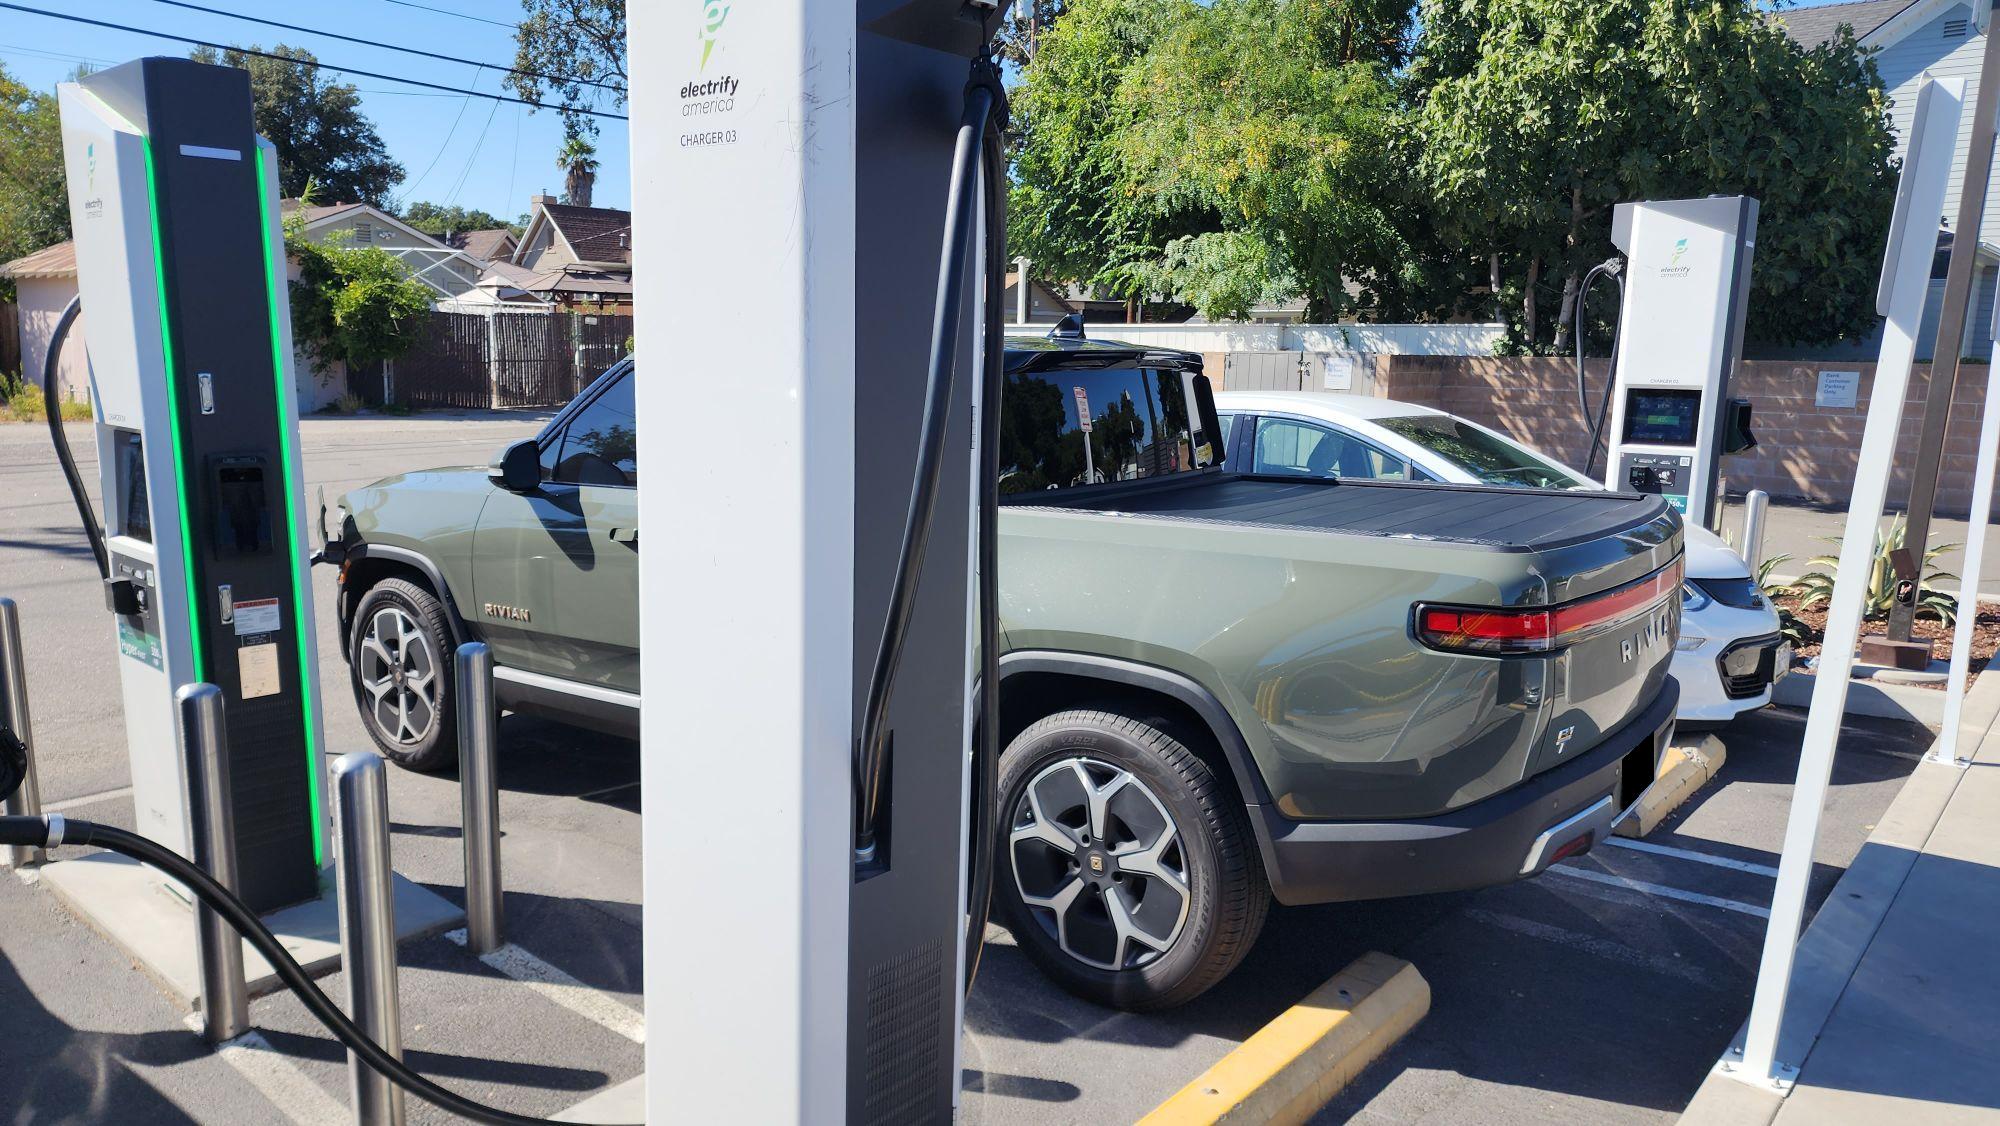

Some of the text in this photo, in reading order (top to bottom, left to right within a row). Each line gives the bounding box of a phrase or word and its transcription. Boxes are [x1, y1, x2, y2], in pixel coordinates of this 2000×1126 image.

[680, 75, 739, 98] electrify
[682, 97, 734, 116] america
[680, 130, 737, 147] CHARGER 03
[484, 603, 531, 622] RIVIAN
